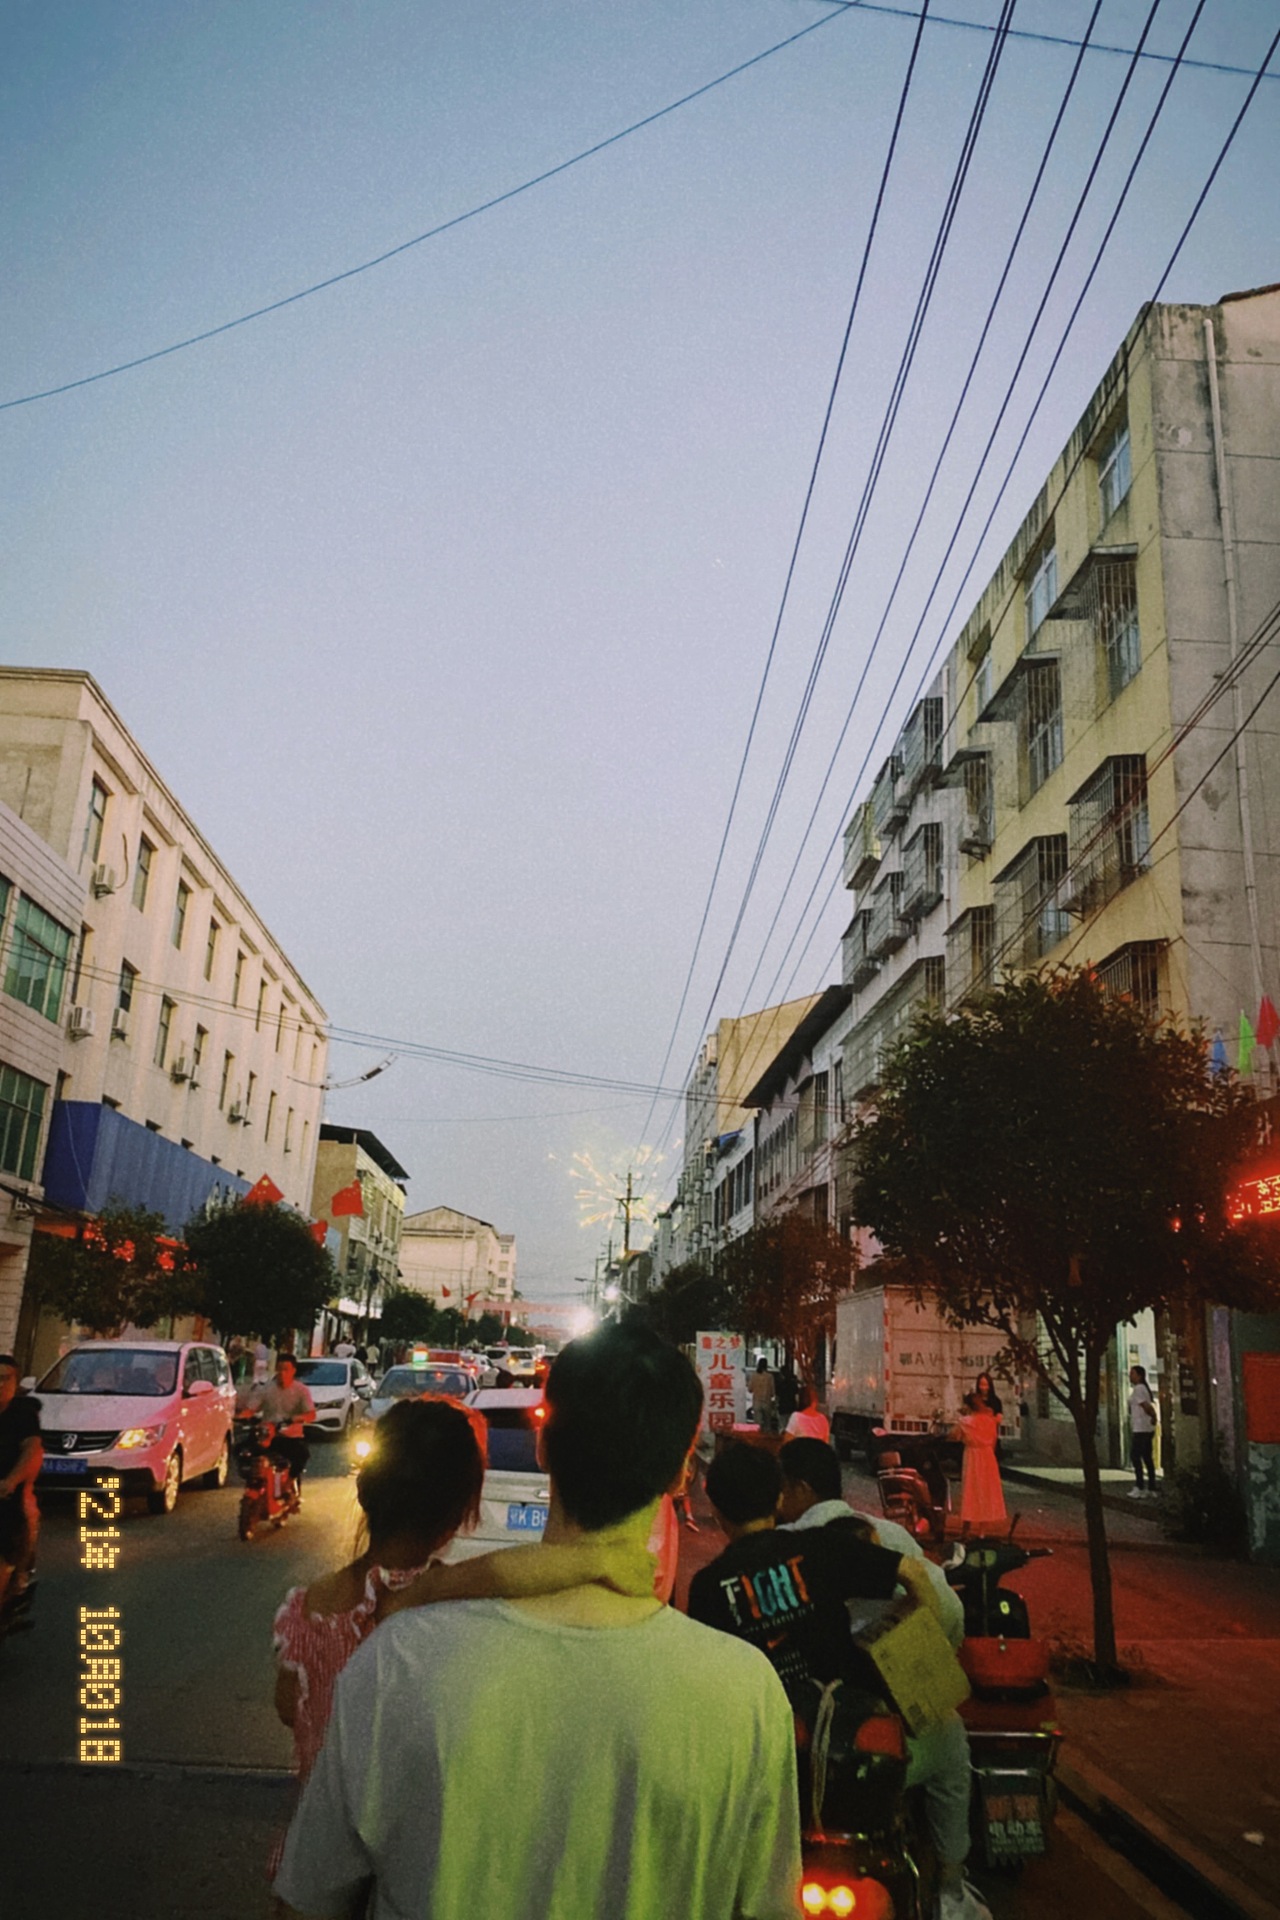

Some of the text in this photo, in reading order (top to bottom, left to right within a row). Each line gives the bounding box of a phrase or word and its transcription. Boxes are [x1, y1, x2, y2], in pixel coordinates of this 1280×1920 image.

[707, 1353, 736, 1430] 儿童乐园
[719, 1554, 810, 1627] FIGHT
